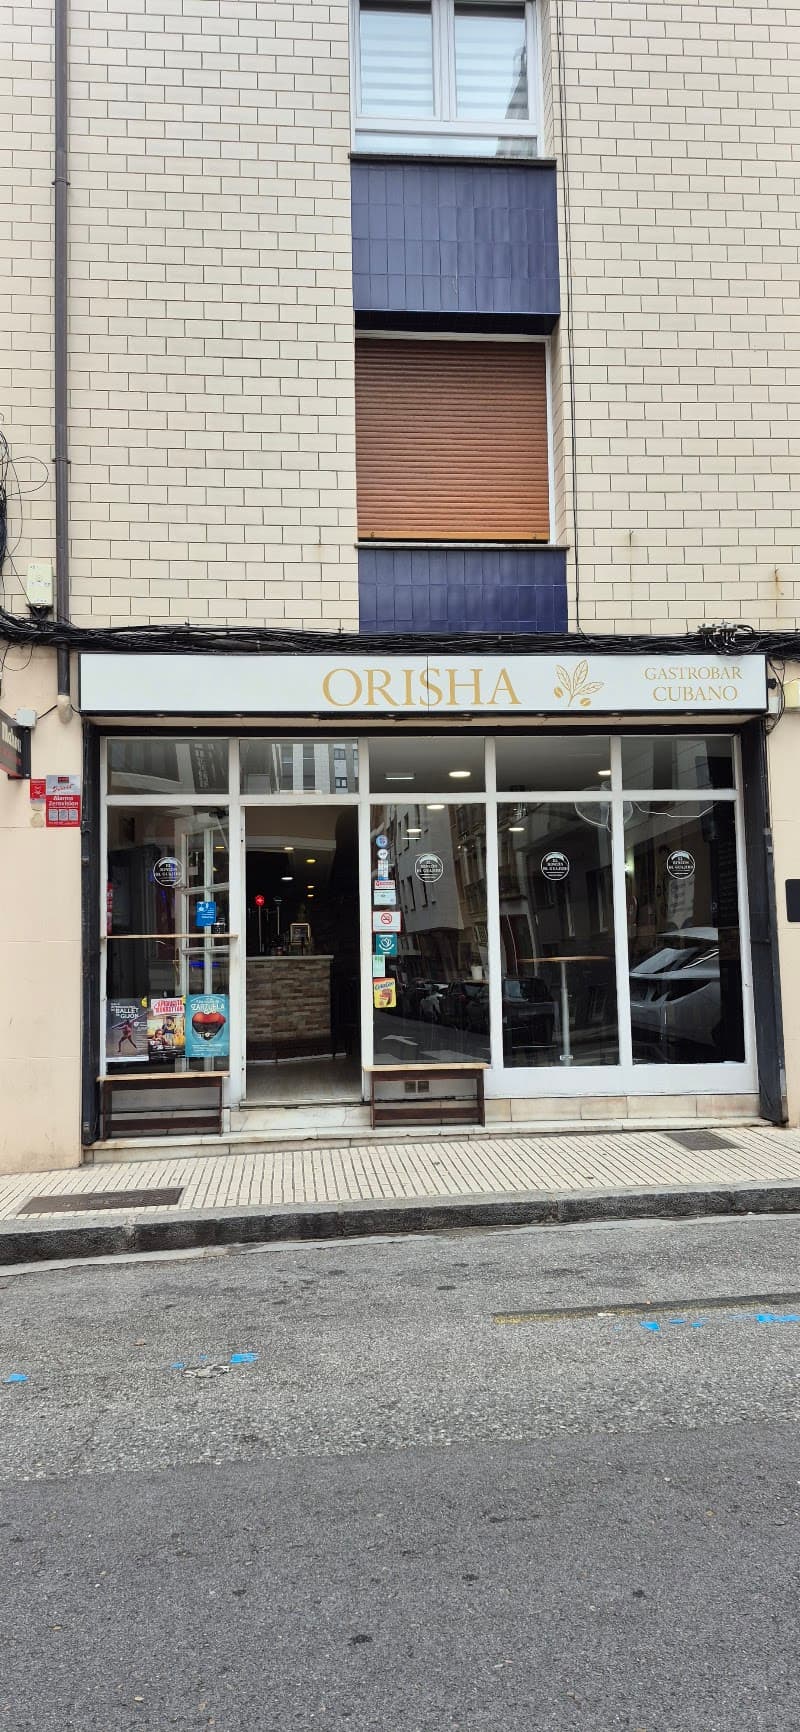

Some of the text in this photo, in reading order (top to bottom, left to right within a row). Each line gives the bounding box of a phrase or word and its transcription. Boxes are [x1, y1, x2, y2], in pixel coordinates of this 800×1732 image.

[644, 666, 743, 680] GASTROBAR
[322, 667, 522, 707] ORISHA
[653, 685, 739, 702] CUBANO
